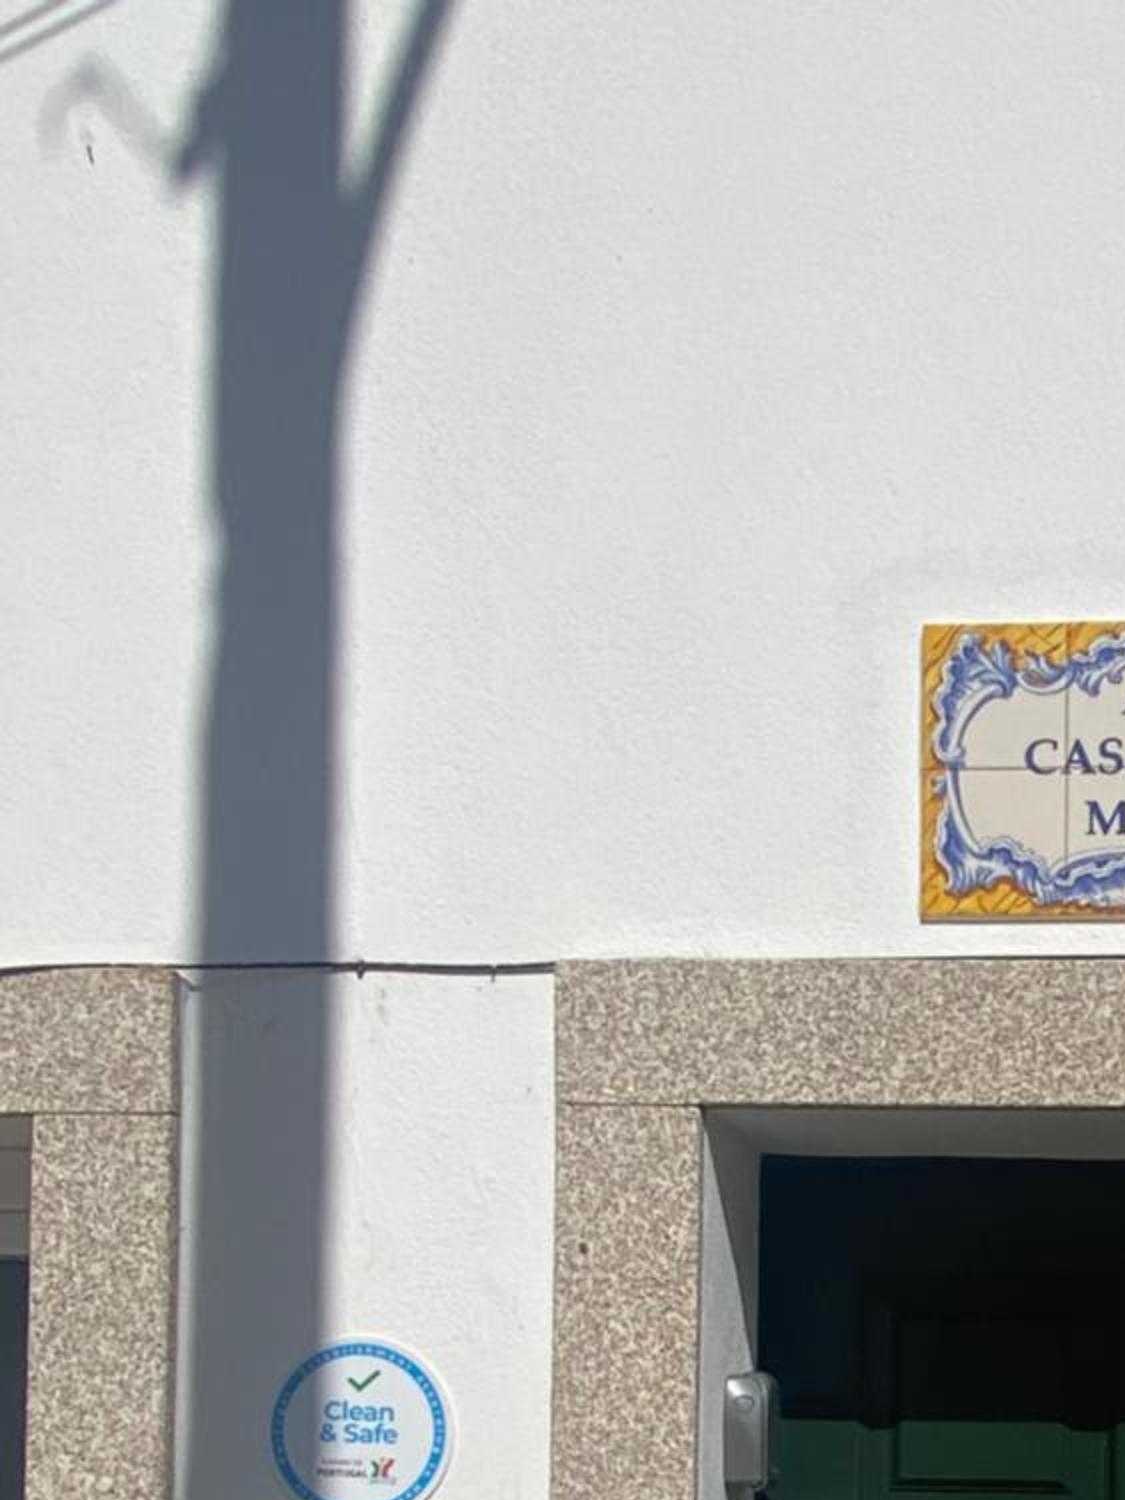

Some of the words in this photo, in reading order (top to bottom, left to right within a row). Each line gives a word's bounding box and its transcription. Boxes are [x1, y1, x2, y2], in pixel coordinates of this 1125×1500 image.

[323, 1400, 395, 1422] Clean
[319, 1423, 337, 1443] &
[343, 1422, 399, 1445] Safe
